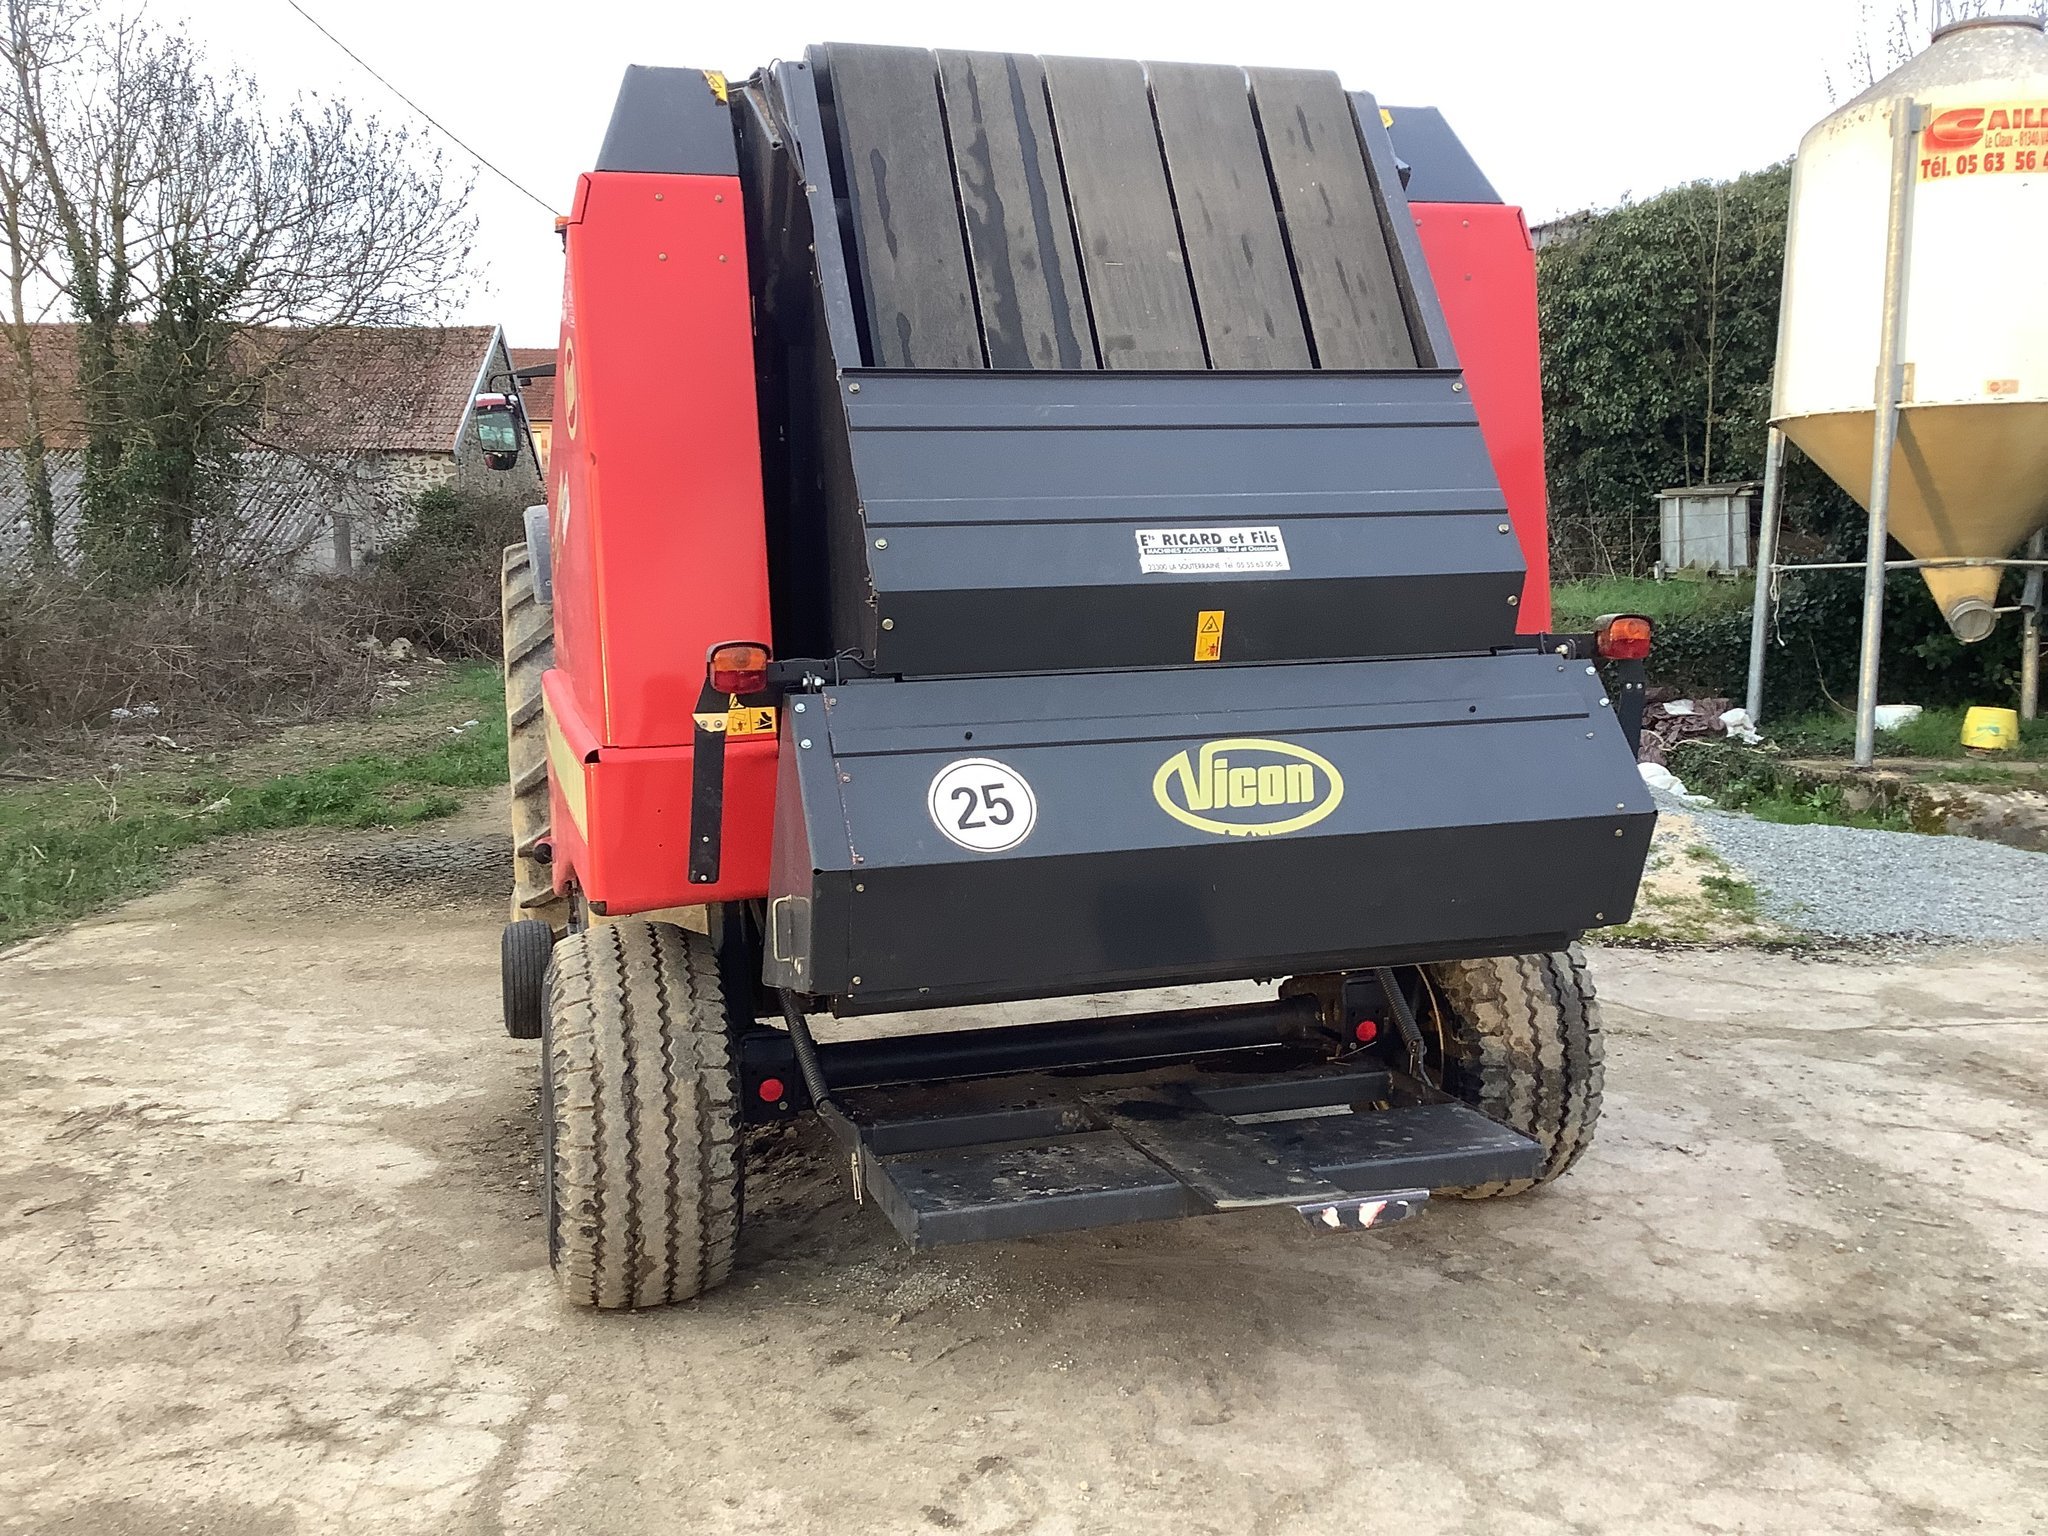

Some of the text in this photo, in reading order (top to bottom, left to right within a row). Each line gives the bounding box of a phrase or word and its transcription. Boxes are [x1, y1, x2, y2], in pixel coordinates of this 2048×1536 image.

[1921, 155, 1951, 178] Tél.
[1956, 154, 1977, 174] 05
[1984, 152, 2004, 172] 63
[2016, 150, 2036, 170] 56
[1162, 533, 1221, 546] RICARD
[1229, 533, 1244, 544] et
[1251, 531, 1277, 543] Fils
[951, 744, 1315, 830] 25 Vicon
